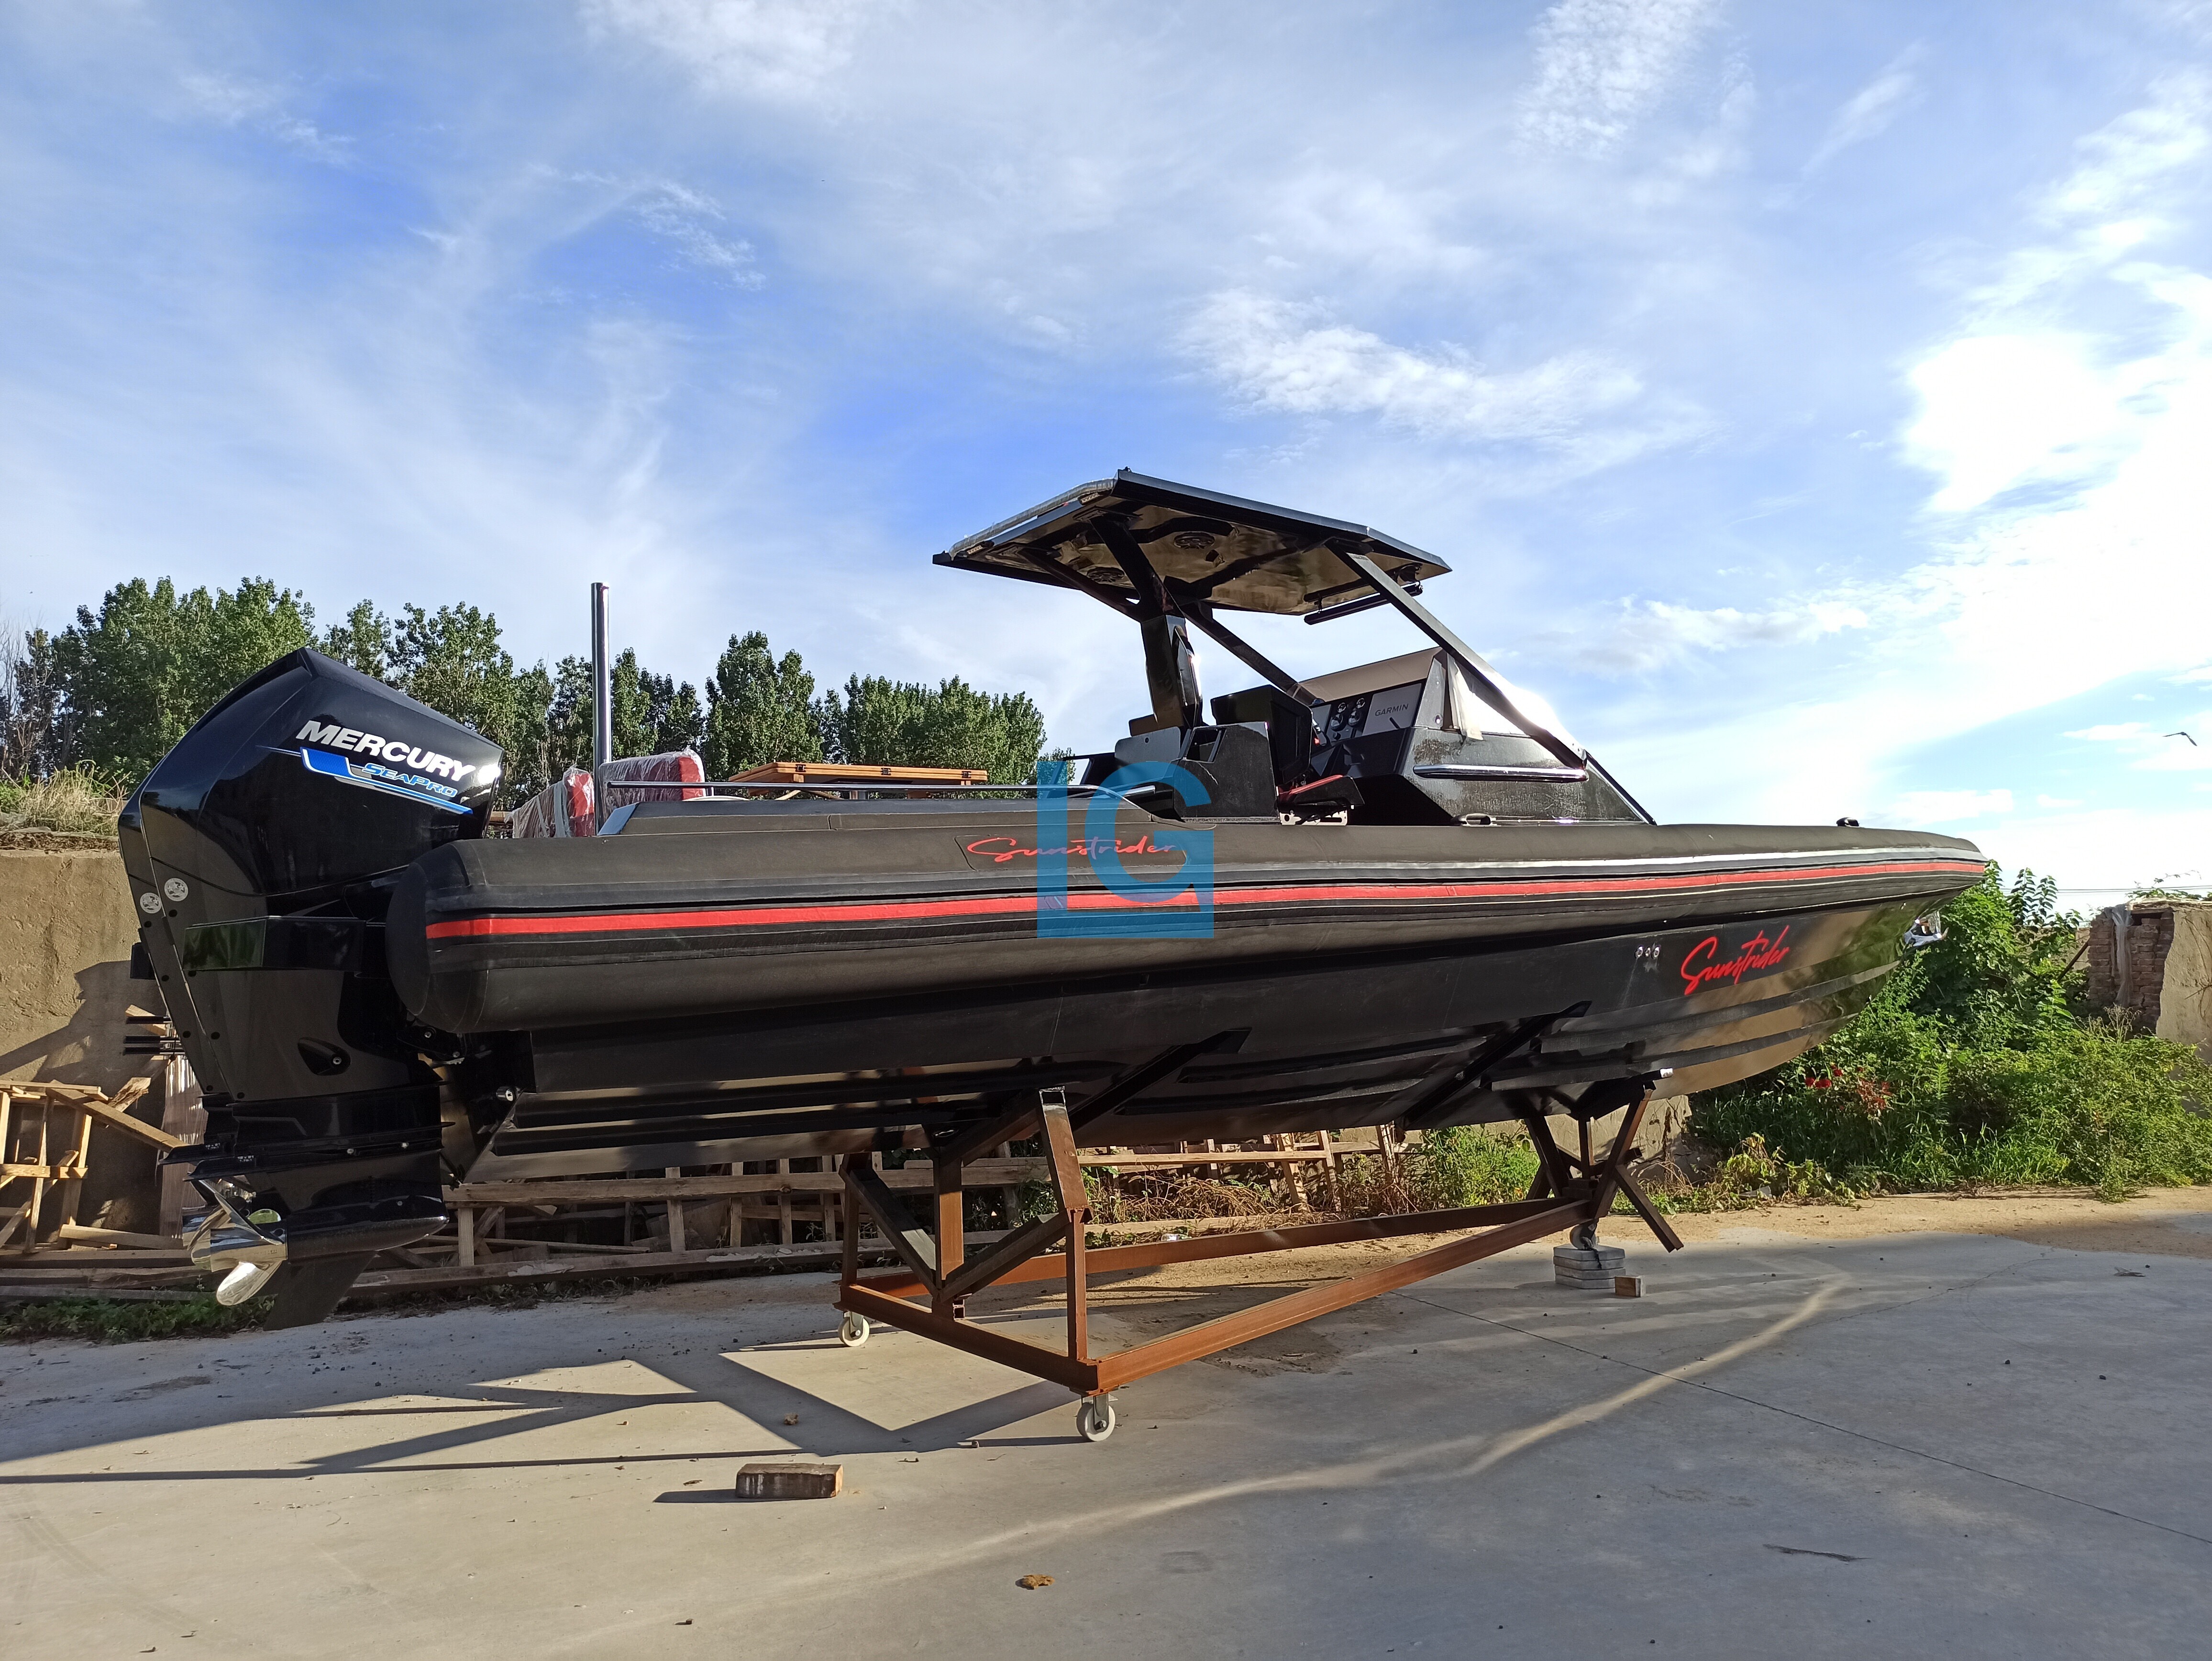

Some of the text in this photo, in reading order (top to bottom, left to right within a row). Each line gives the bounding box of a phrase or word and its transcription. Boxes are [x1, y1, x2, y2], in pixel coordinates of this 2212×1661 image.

[1375, 703, 1409, 716] GARMIN
[296, 720, 476, 781] MERCURY
[967, 836, 1176, 862] Sunstrider
